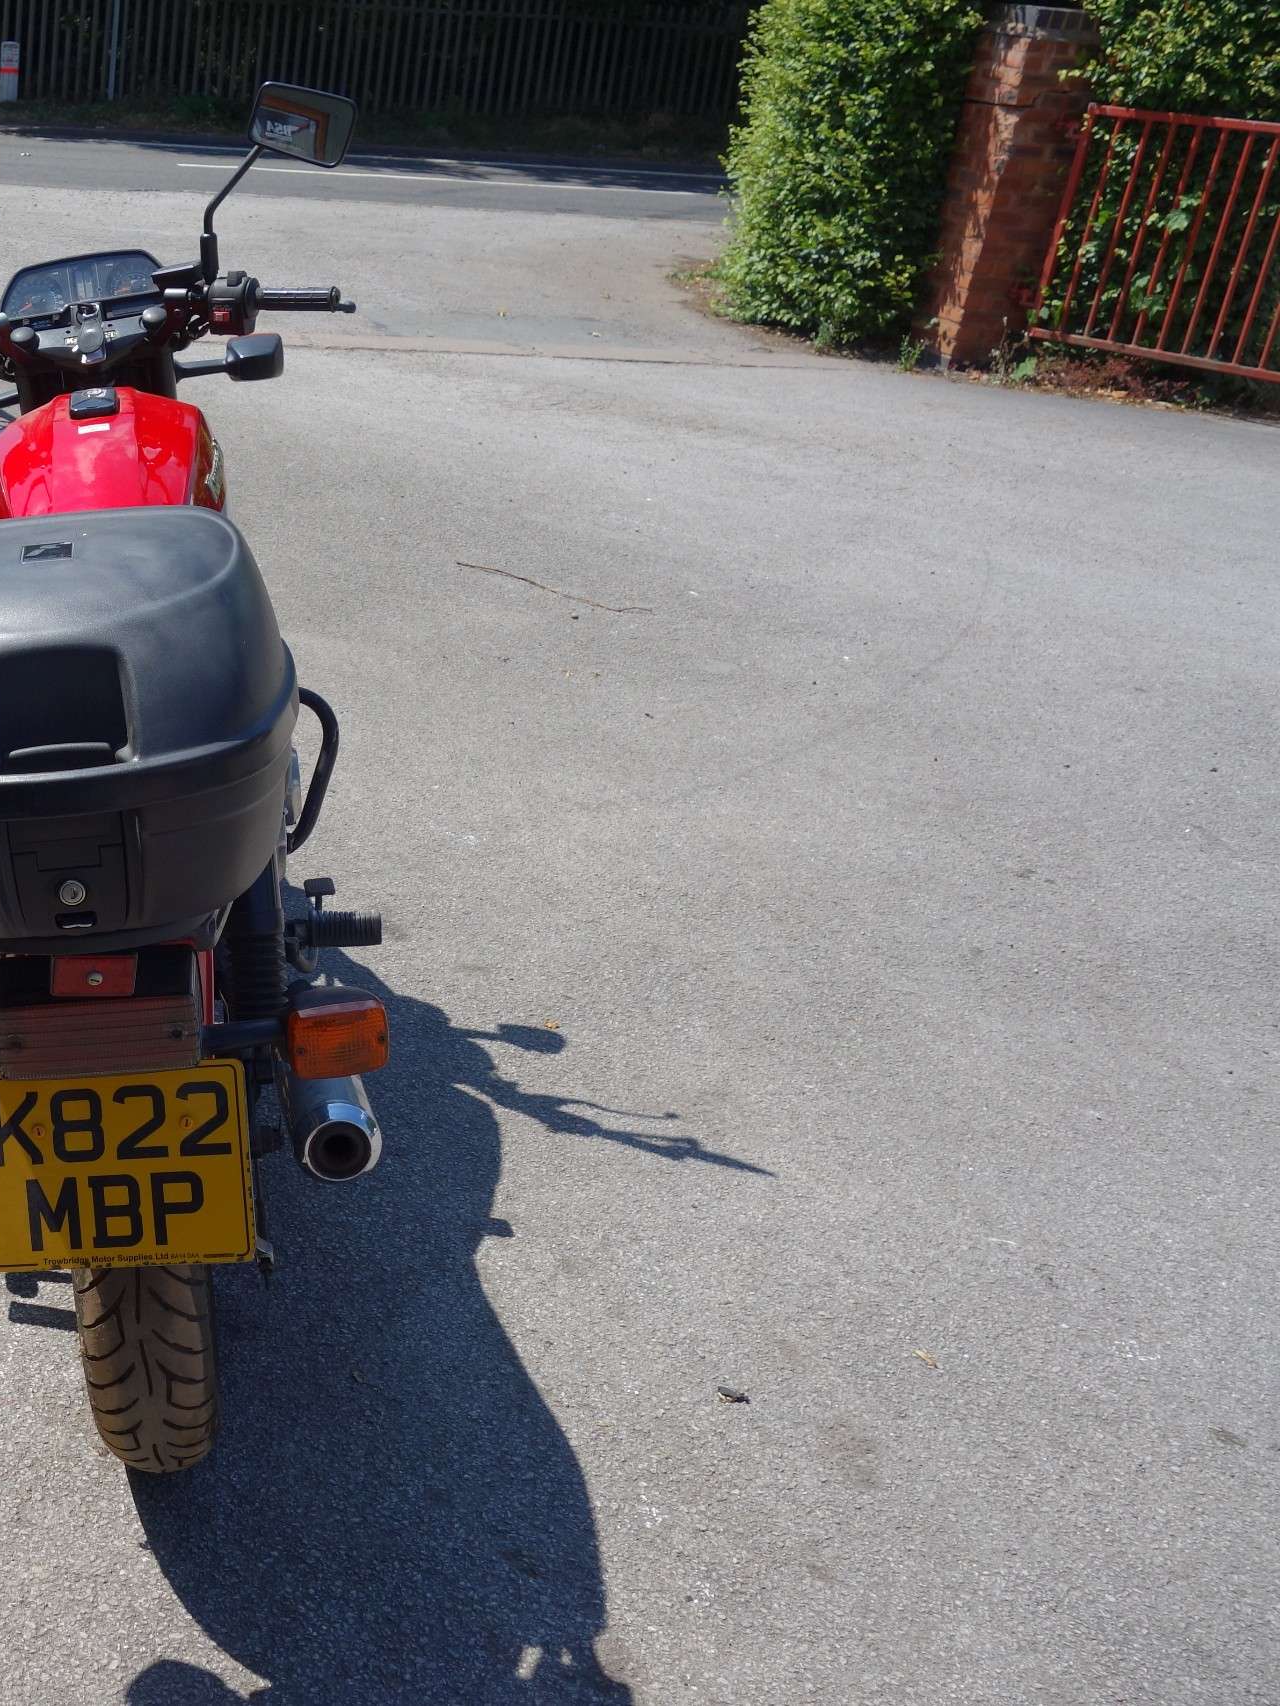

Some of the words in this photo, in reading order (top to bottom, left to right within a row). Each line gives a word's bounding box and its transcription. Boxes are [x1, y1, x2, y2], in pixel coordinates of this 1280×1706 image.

[25, 1171, 204, 1251] MBP
[43, 1256, 90, 1266] Trowbridge
[92, 1255, 115, 1263] Motor
[117, 1253, 153, 1263] Supplies
[156, 1252, 169, 1260] Ltd
